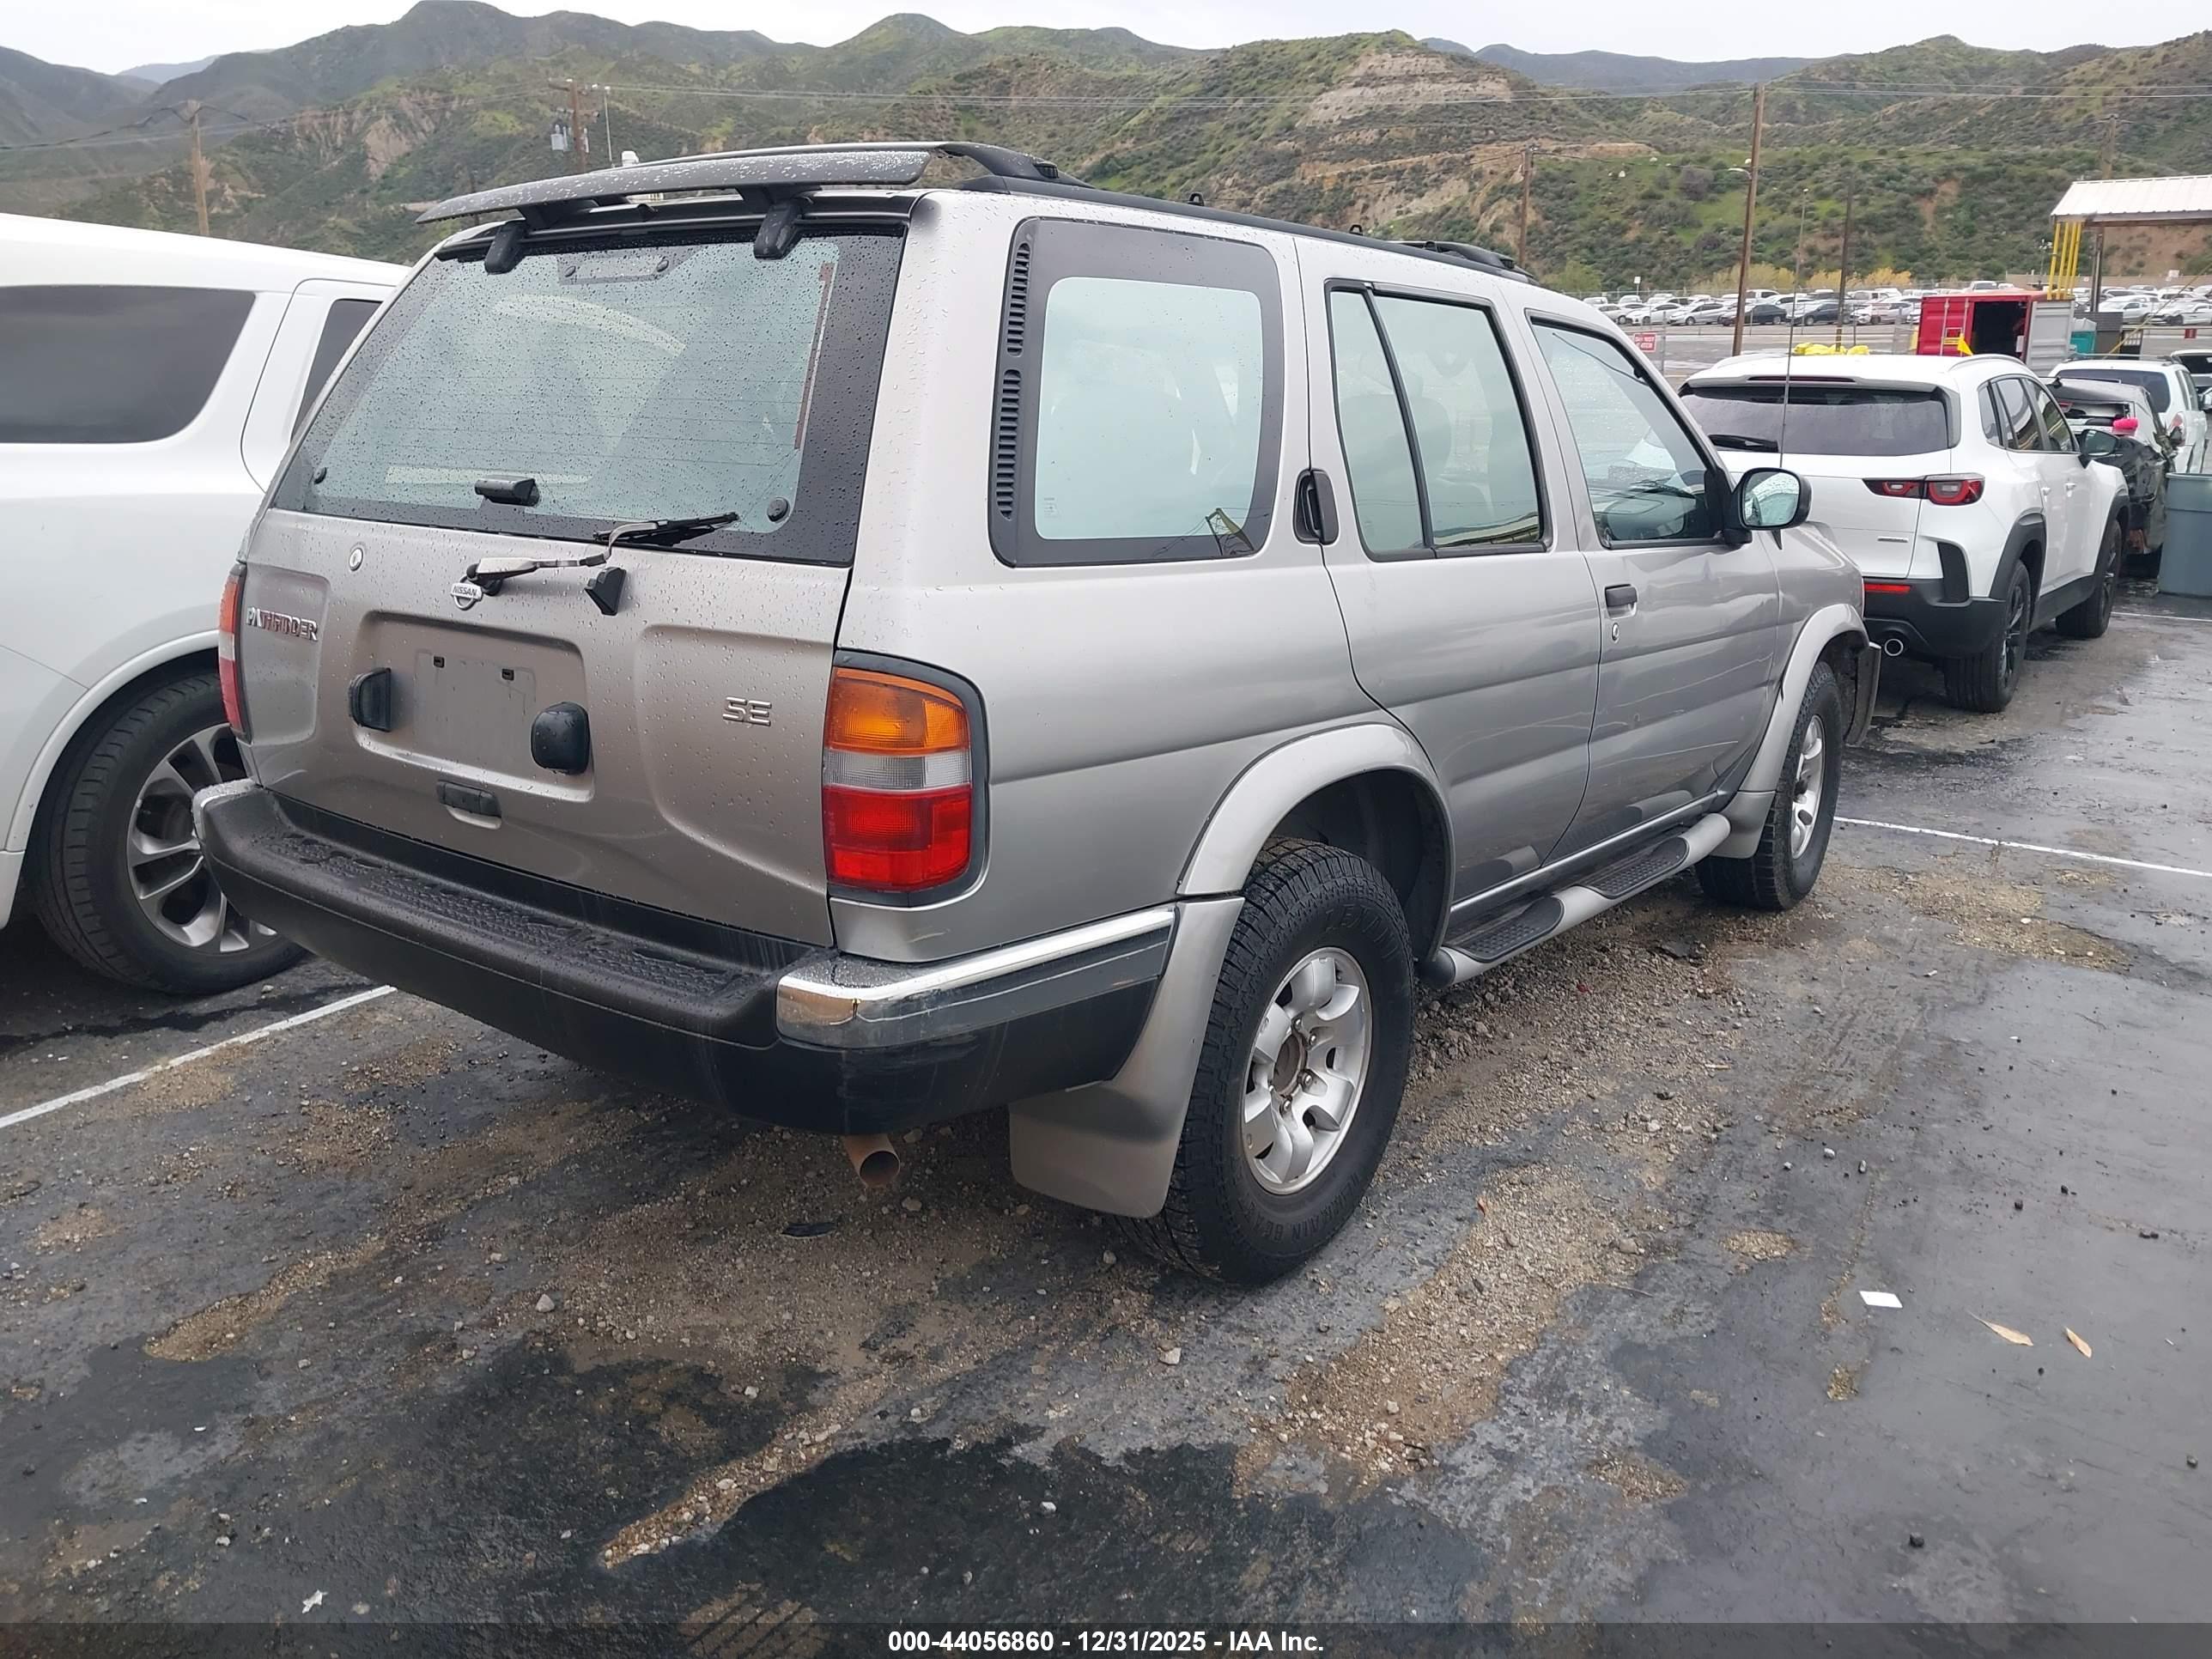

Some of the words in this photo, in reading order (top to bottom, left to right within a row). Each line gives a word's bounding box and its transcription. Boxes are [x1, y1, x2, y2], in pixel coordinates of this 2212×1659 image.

[453, 585, 478, 597] NISSAN
[246, 606, 318, 642] PATHFINDER
[722, 696, 772, 727] SE
